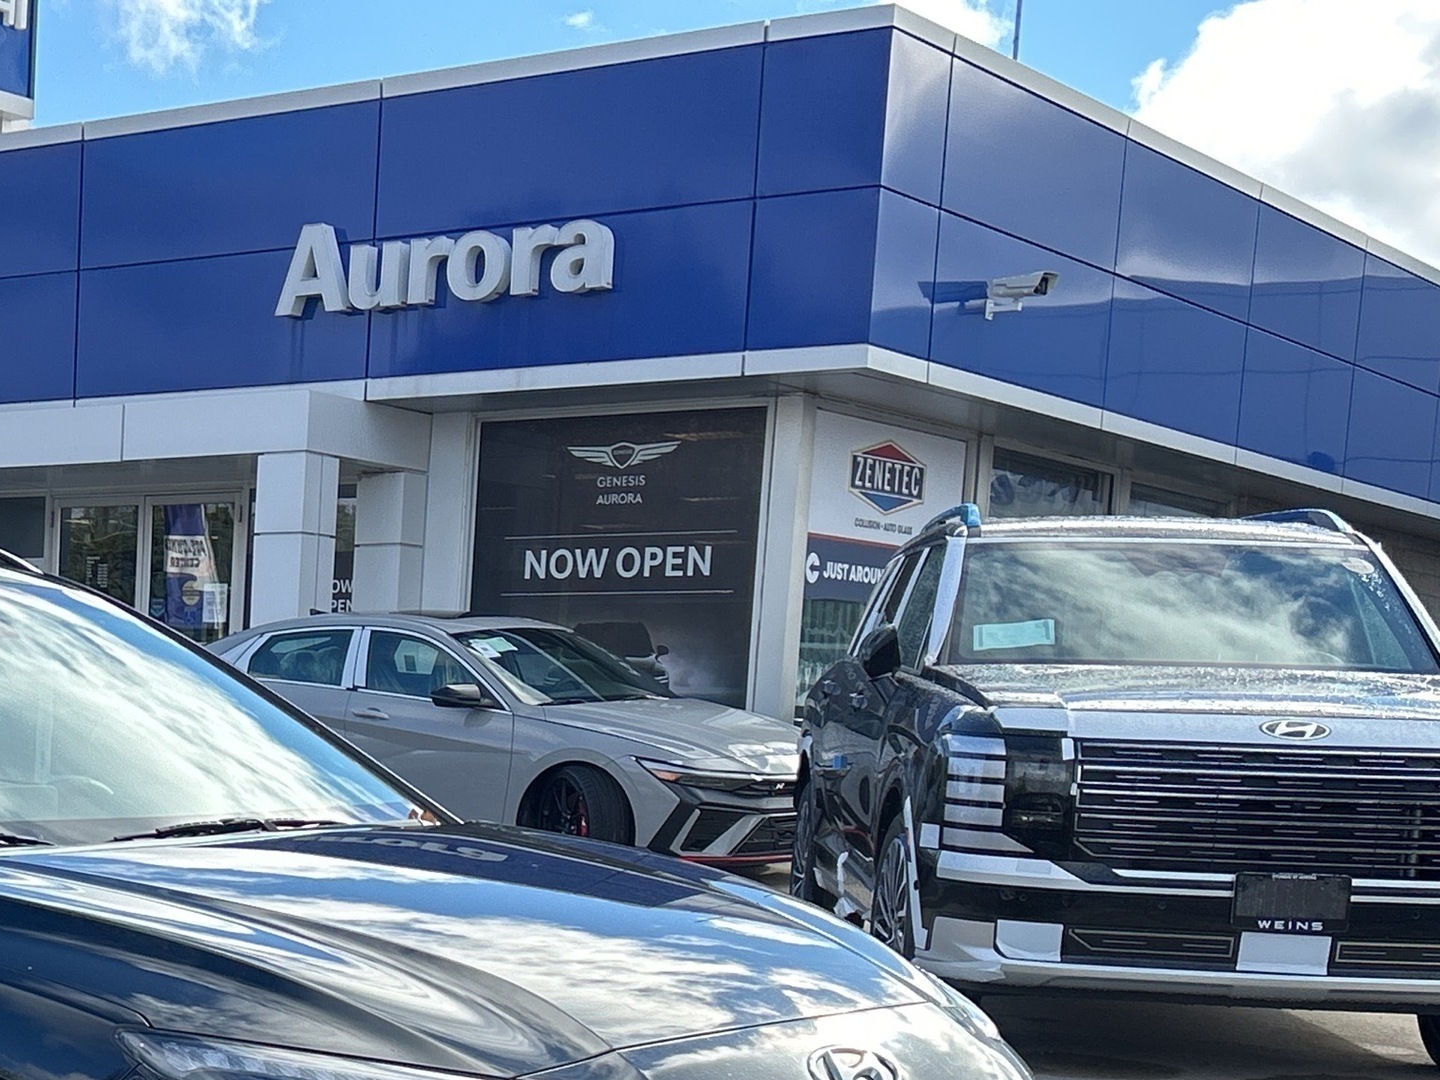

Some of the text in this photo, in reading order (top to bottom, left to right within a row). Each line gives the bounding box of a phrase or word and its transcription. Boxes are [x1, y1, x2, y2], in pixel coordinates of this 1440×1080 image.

[274, 218, 615, 318] Aurora
[596, 474, 646, 488] GENESIS
[854, 457, 921, 496] ZENETEC
[595, 492, 643, 505] AURORA
[524, 545, 713, 580] NOW OPEN
[823, 561, 885, 585] JUST AROUN
[332, 579, 353, 594] OW
[331, 599, 353, 613] PEN
[1258, 920, 1324, 931] WEINS
